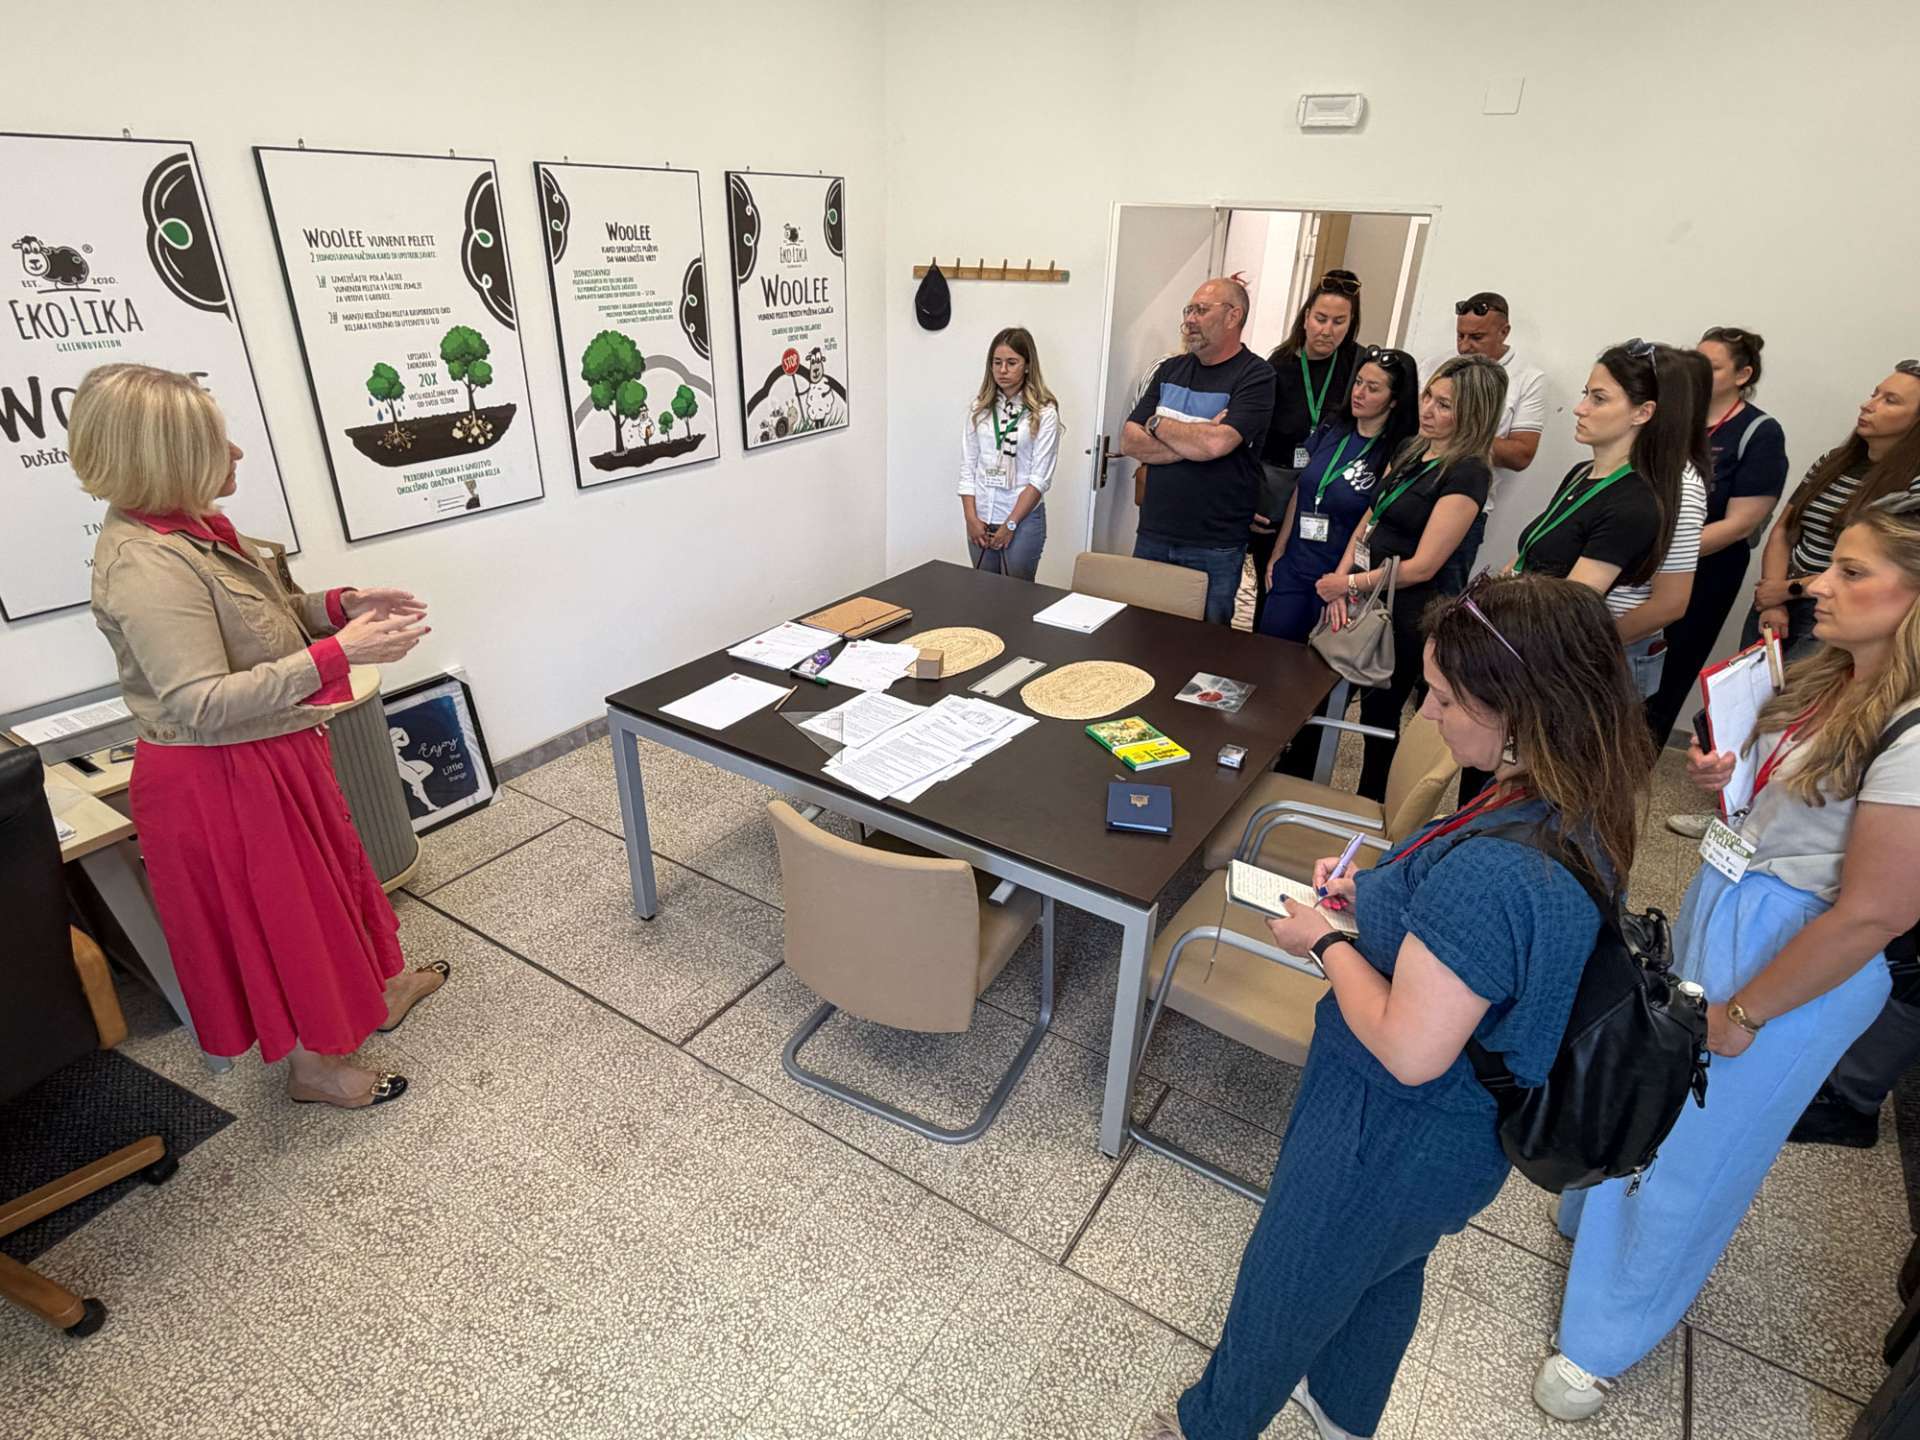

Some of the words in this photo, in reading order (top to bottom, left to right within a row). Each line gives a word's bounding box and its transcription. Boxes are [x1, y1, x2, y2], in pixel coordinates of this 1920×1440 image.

[302, 228, 365, 248] WOOLEE
[367, 235, 406, 247] VUNENI
[407, 235, 435, 246] PELETI
[605, 222, 652, 241] WOOLEE
[760, 274, 829, 307] WOOLEE
[8, 296, 144, 340] EKO-LIKA
[56, 340, 122, 352] GREENNOVATION
[783, 353, 798, 371] STOP
[418, 372, 438, 387] 20X
